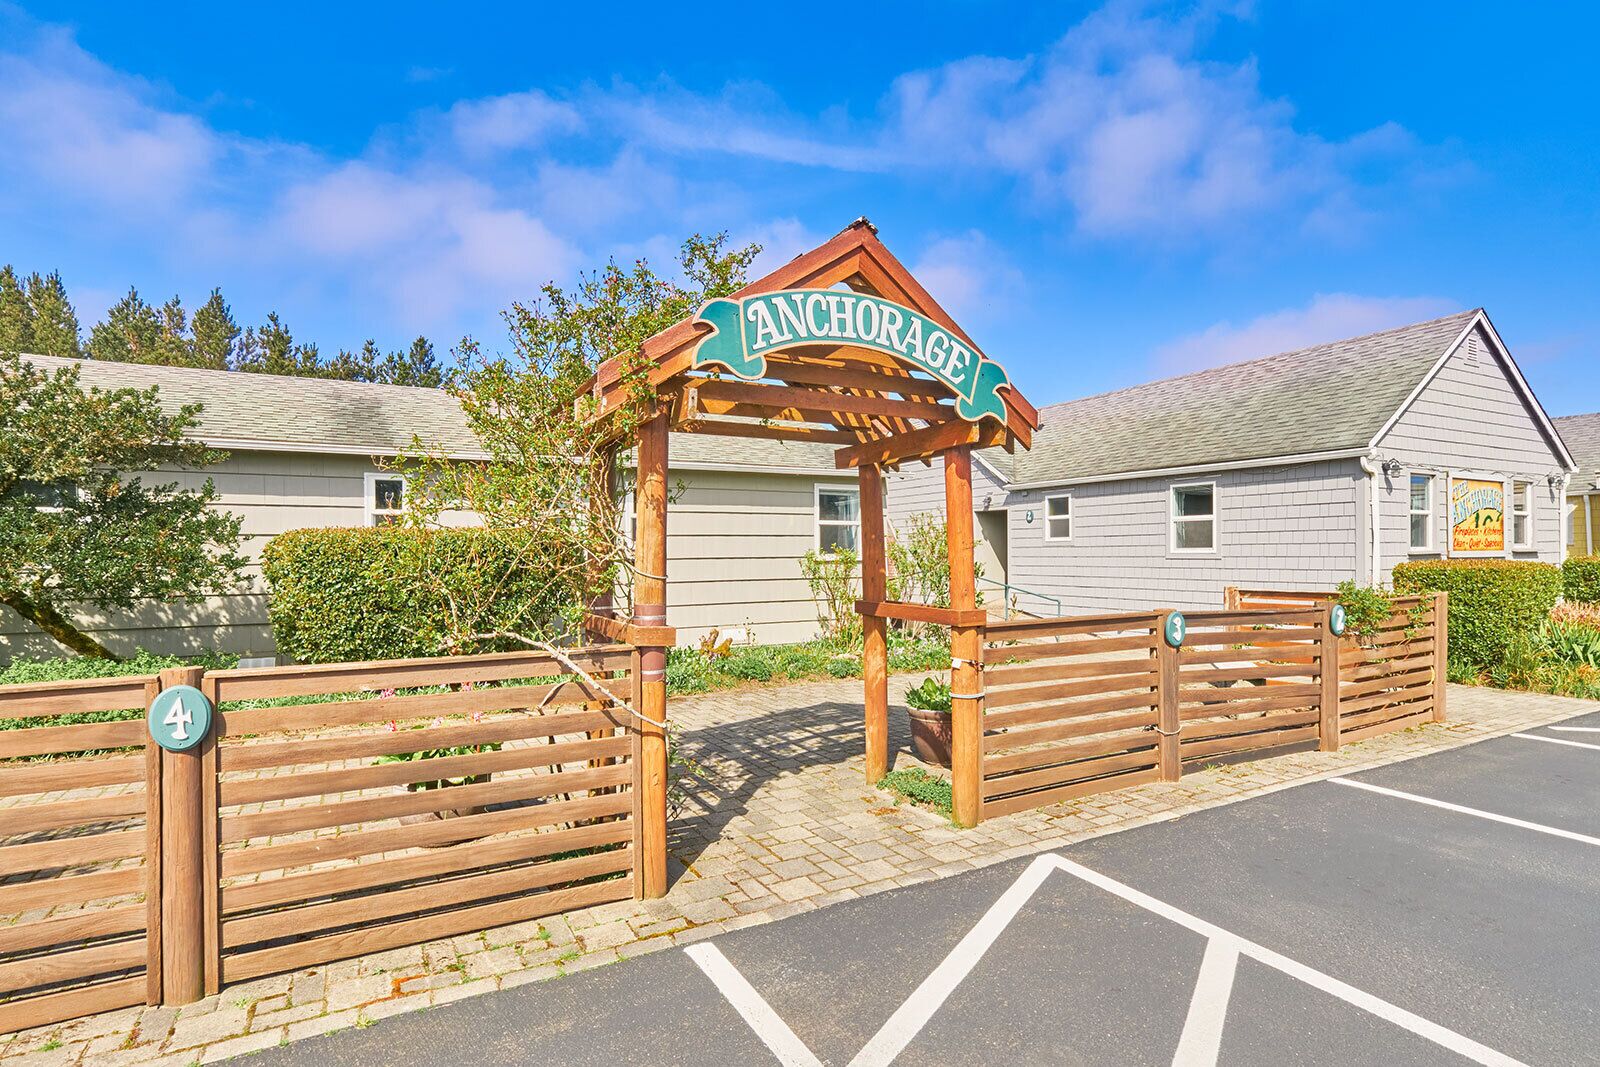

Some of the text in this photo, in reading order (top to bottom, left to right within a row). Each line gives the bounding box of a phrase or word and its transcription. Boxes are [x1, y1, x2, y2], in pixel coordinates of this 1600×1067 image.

[747, 292, 972, 385] ANCHORAGE
[1453, 481, 1469, 499] THE
[1452, 488, 1503, 524] ANCHORAGE
[1172, 616, 1182, 641] 3
[1336, 608, 1345, 631] 2
[163, 696, 193, 740] 4
